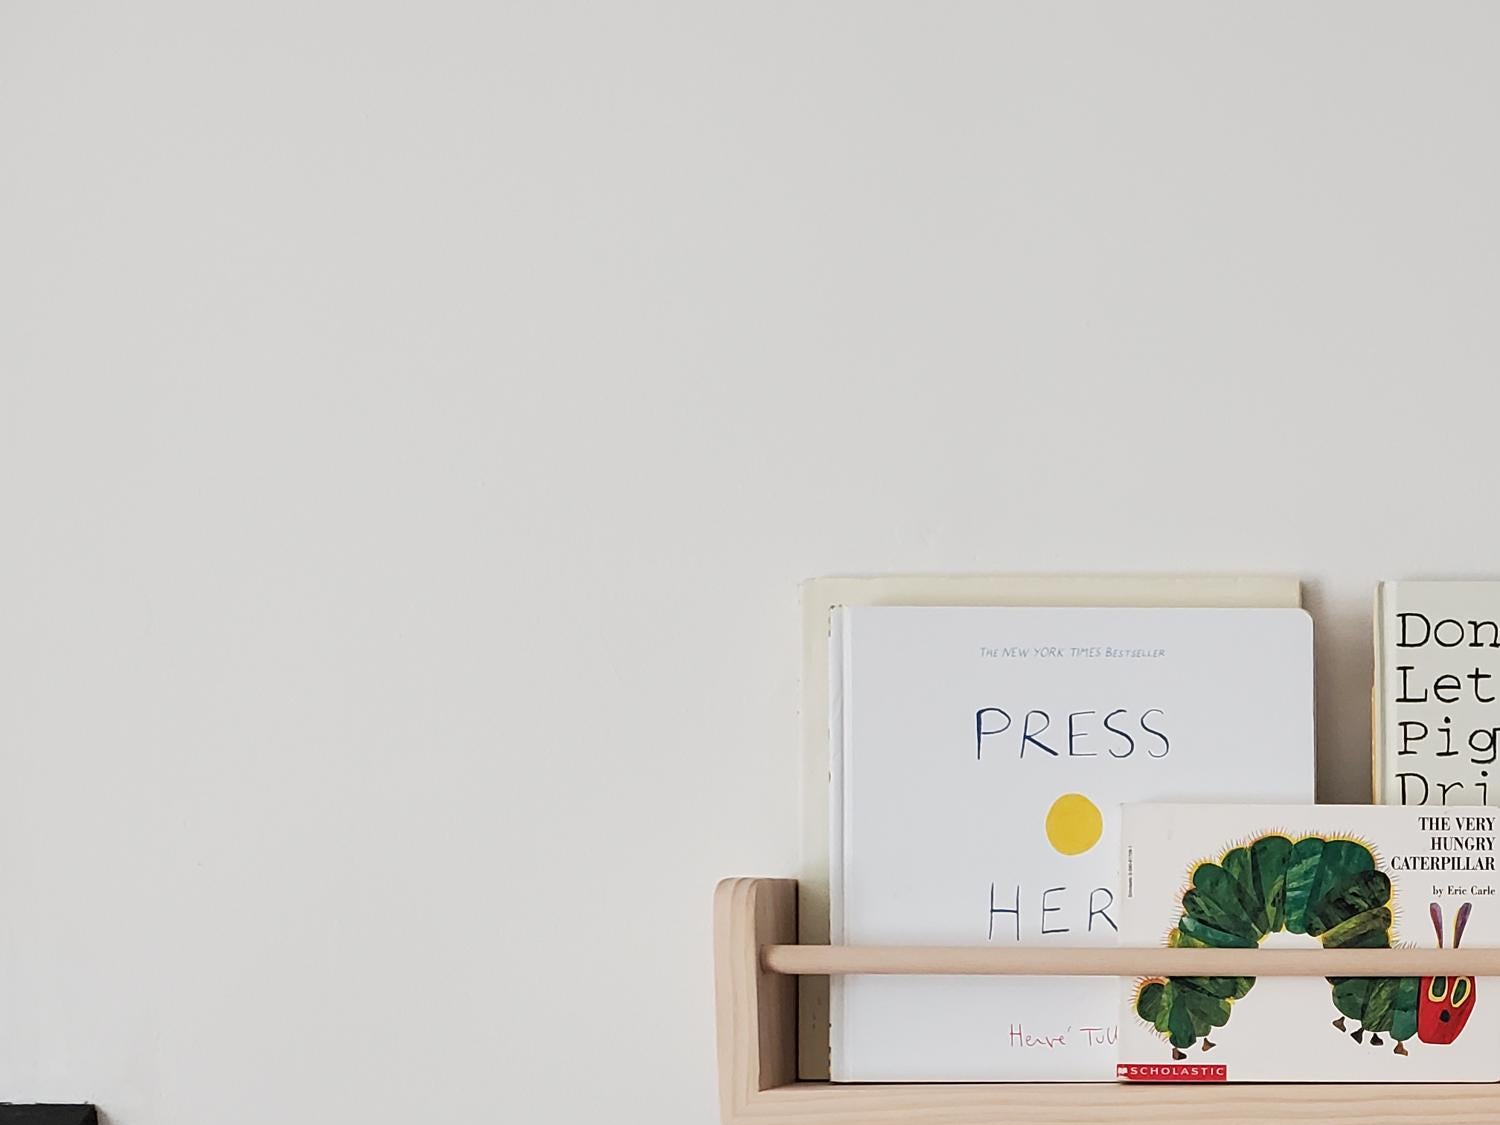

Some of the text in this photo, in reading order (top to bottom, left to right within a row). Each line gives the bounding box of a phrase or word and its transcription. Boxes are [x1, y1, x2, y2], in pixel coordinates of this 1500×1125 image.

[980, 647, 1166, 657] THE NEW YORK TIMES BESTSELLER
[1396, 666, 1497, 704] Let
[976, 707, 1170, 760] PRESS
[1418, 816, 1496, 831] THE VERY
[1430, 836, 1496, 851] HUNGRY
[1390, 856, 1496, 871] CATERPILLAR
[1432, 885, 1496, 897] by Eric Carle
[988, 882, 1119, 942] HER
[1080, 1026, 1119, 1047] Tull
[1130, 1066, 1225, 1077] SCHOLASTIC
